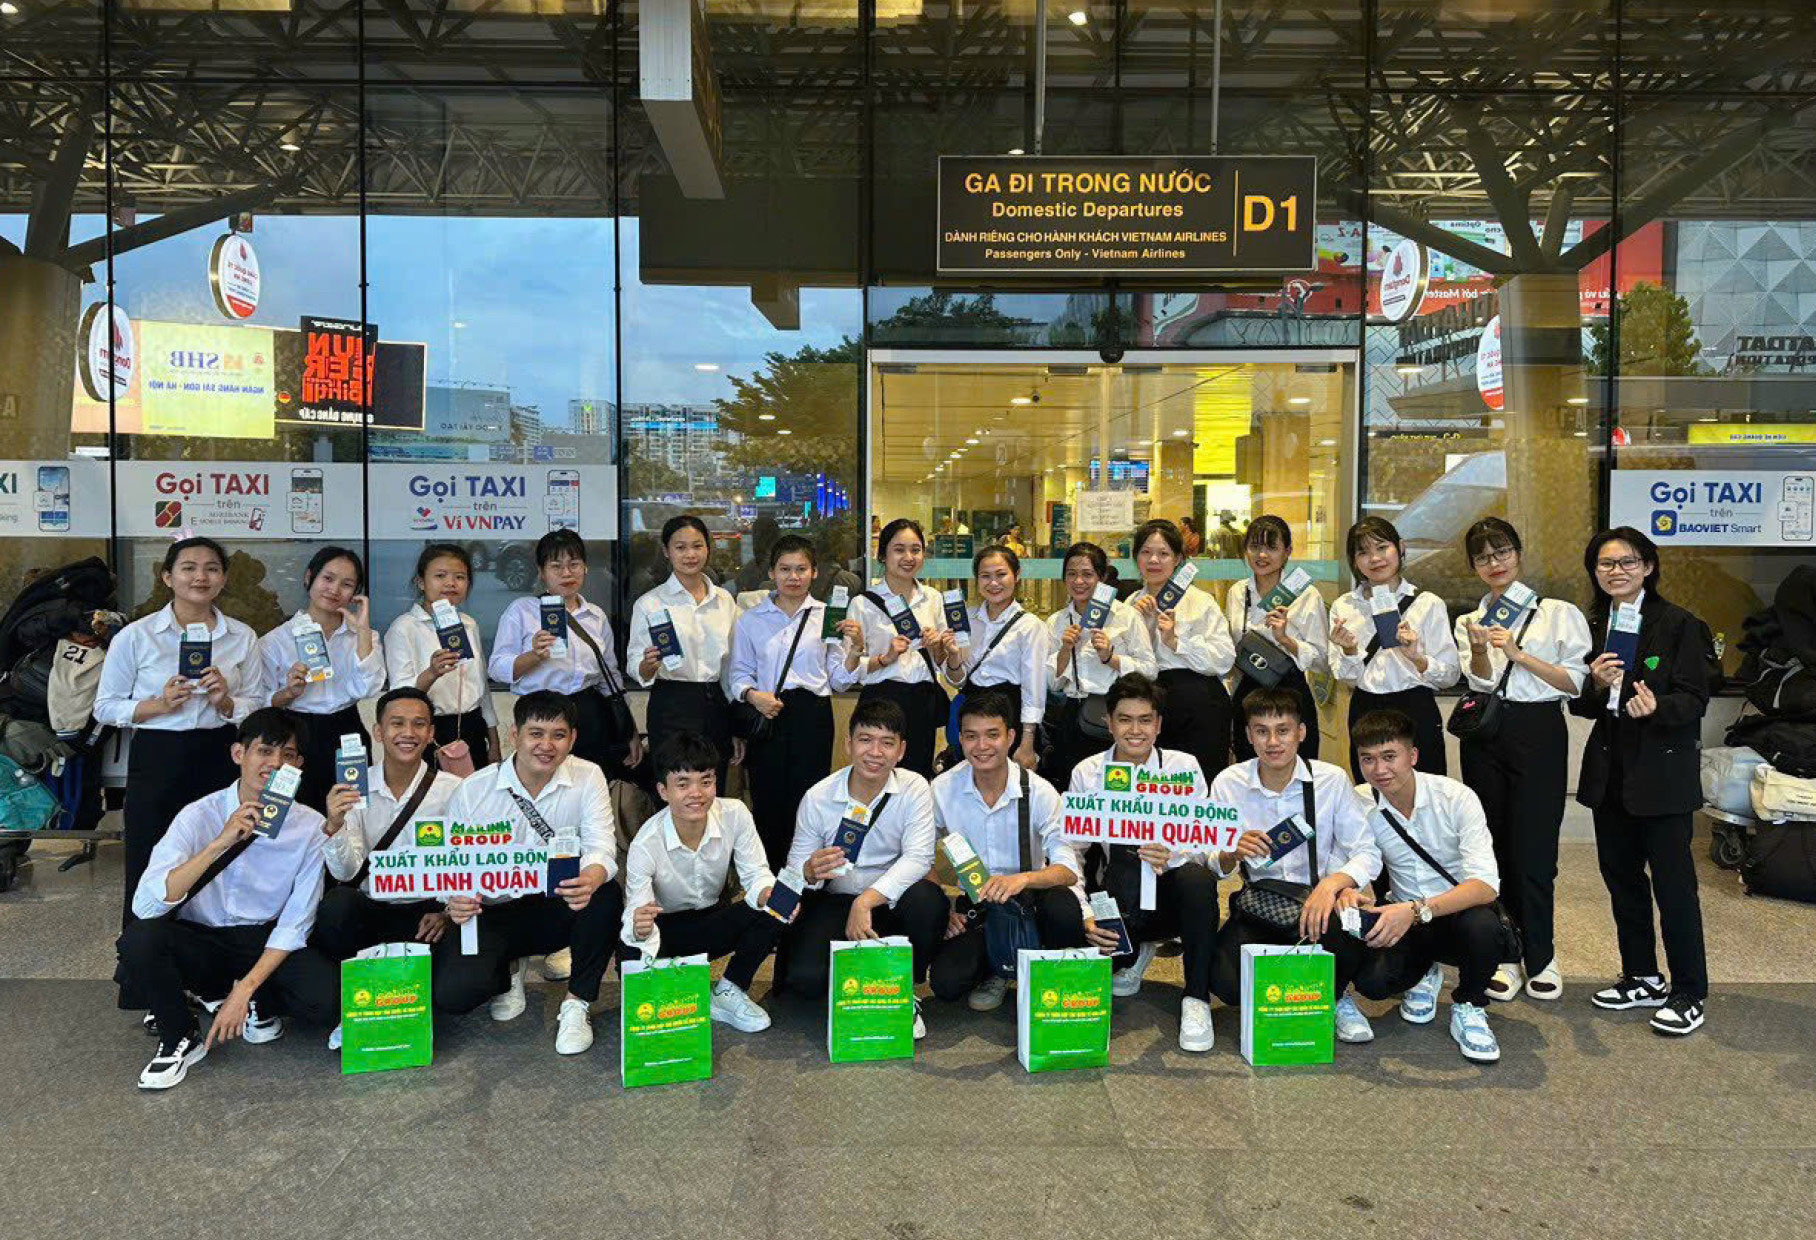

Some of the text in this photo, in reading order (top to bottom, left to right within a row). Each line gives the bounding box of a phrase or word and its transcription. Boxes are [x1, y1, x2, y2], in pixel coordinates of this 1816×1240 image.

[964, 168, 1212, 194] GA ĐI TRONG NƯỚC
[992, 202, 1184, 220] Domestic Departures
[1243, 194, 1297, 232] D1
[945, 230, 1226, 242] DÀNH RIÊNG CHO HÀNH KHÁCH VIETNAM AIRLINES
[985, 248, 1052, 260] Passengers
[1054, 248, 1081, 260] Only
[1092, 248, 1138, 259] Vietnam
[1142, 248, 1186, 259] Airlines
[156, 472, 269, 500] Gọi TAXI
[409, 476, 525, 503] Gọi TAXI
[217, 500, 240, 509] trên
[1650, 482, 1762, 510] Gọi TAXI
[473, 501, 497, 510] trên
[1710, 508, 1734, 518] trên
[444, 515, 462, 530] Ví
[466, 516, 526, 530] VNPAY
[1679, 523, 1762, 533] BAOVIET Smart
[62, 645, 88, 664] 21
[1135, 783, 1195, 796] GROUP
[1066, 793, 1238, 822] XUẤT KHẨU LAO ĐỘNG
[450, 834, 512, 846] GROUP
[1064, 816, 1236, 848] MAI LINH QUẬN 7
[374, 848, 548, 868] XUẤT KHẨU LAO ĐỘN
[374, 866, 539, 892] MAI LINH QUẬN
